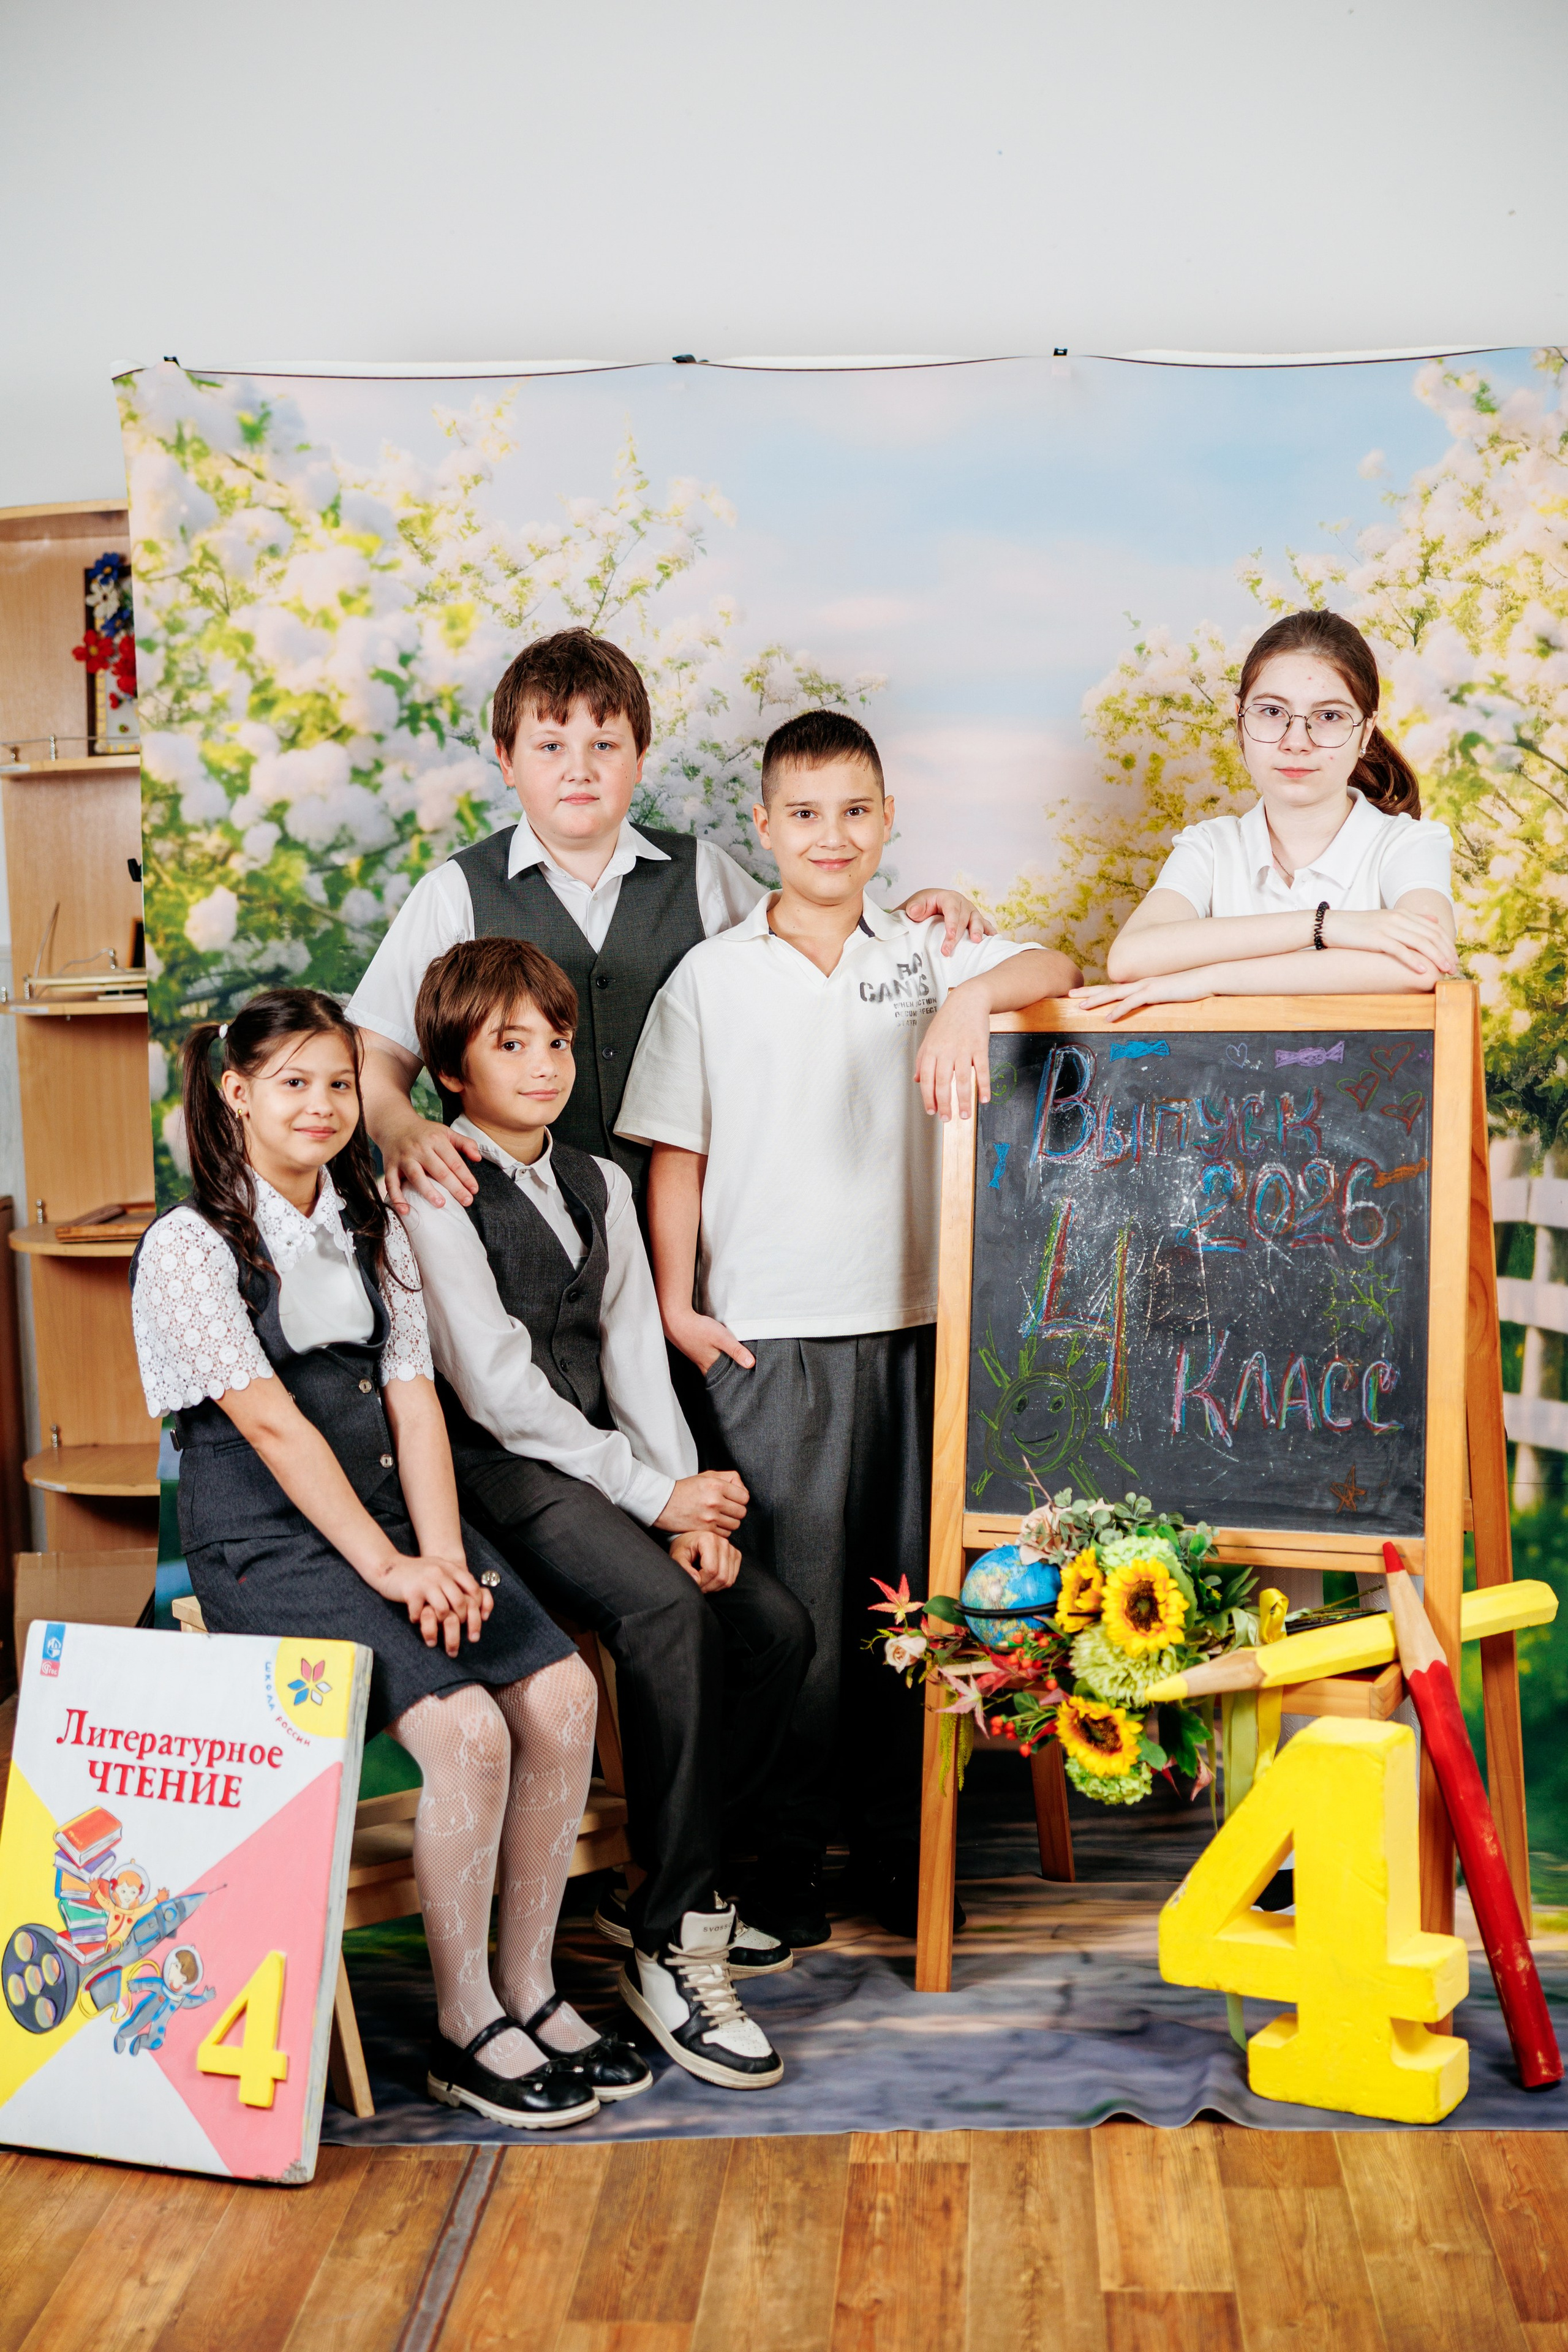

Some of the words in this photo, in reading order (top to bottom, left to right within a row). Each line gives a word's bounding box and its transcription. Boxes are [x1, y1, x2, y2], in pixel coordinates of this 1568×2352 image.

[1176, 1156, 1393, 1253] 2026
[56, 1708, 284, 1769] Литературное
[88, 1760, 243, 1809] ЧТЕНИЕ
[1159, 1715, 1469, 2124] 4
[197, 1950, 288, 2108] 4
